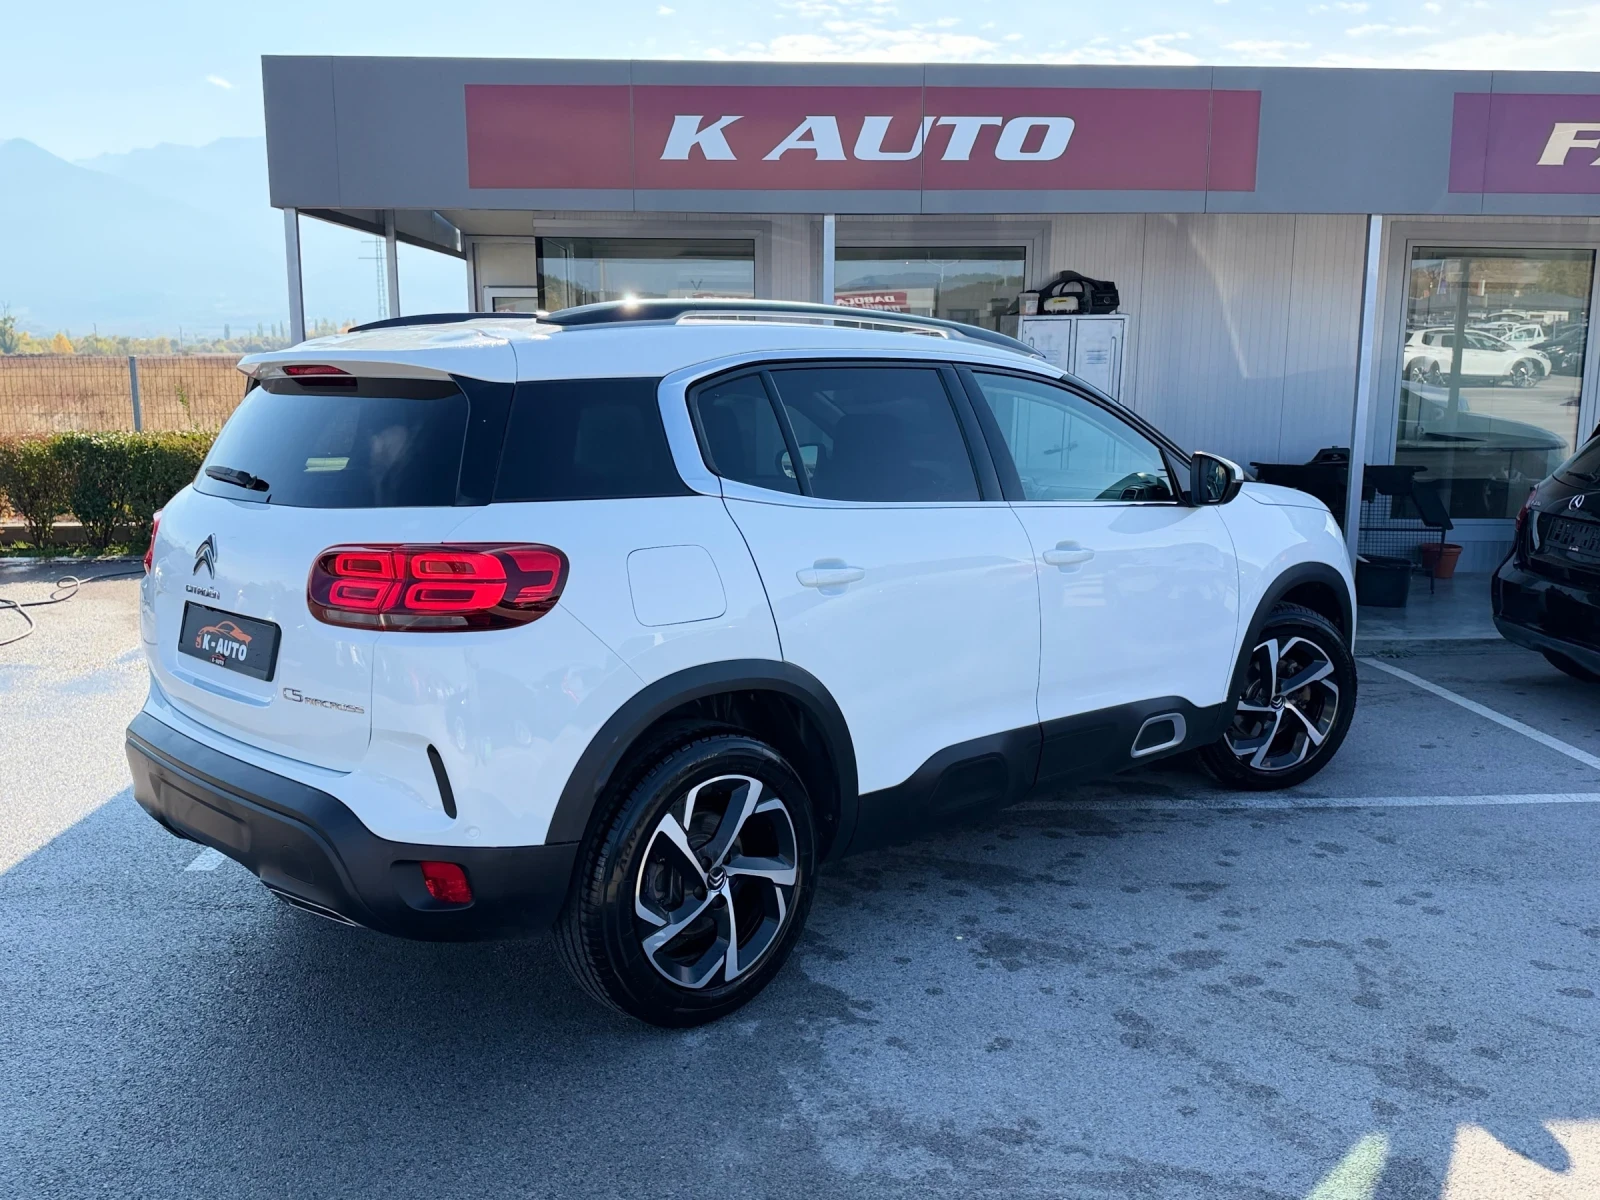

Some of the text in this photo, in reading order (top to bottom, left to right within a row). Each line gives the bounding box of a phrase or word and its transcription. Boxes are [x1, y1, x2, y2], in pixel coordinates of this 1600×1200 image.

[659, 114, 1076, 162] K AUTO
[1535, 122, 1600, 166] F
